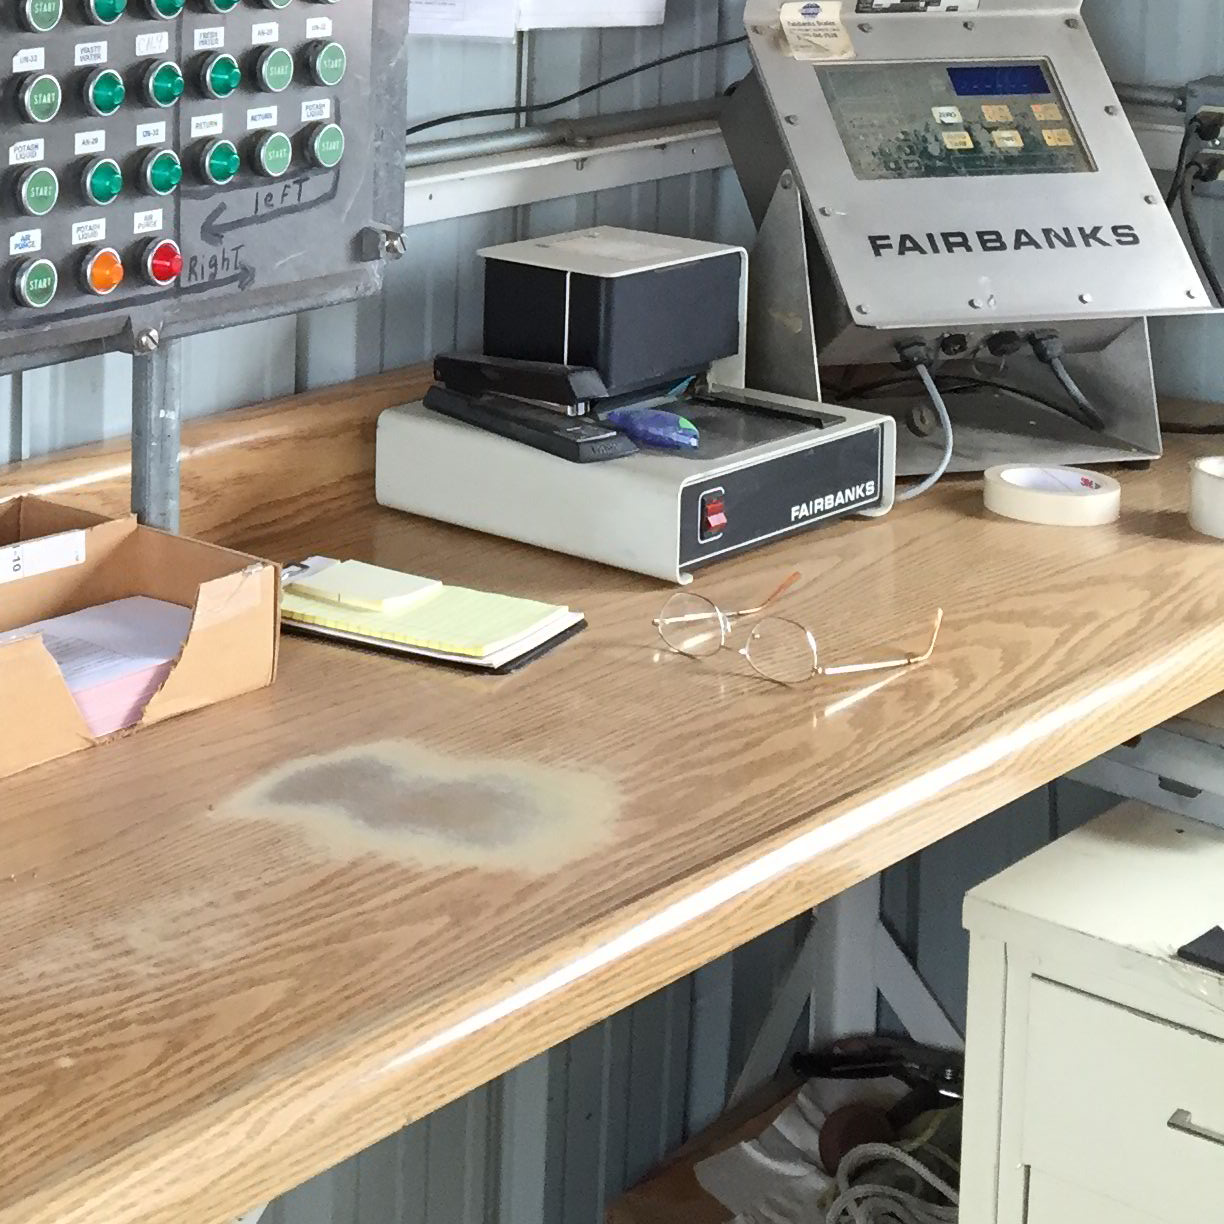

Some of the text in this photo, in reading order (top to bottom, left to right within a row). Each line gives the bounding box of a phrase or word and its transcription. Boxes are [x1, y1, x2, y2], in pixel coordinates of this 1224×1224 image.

[34, 2, 57, 14] START
[323, 58, 342, 69] START
[269, 65, 289, 76] START
[33, 92, 56, 105] START
[195, 120, 218, 129] RETURN
[321, 140, 341, 151] START
[268, 149, 287, 161] START
[30, 186, 54, 198] START
[867, 224, 1140, 257] FAIRBANKS
[29, 277, 52, 290] START
[790, 480, 875, 522] FAIRBANKS
